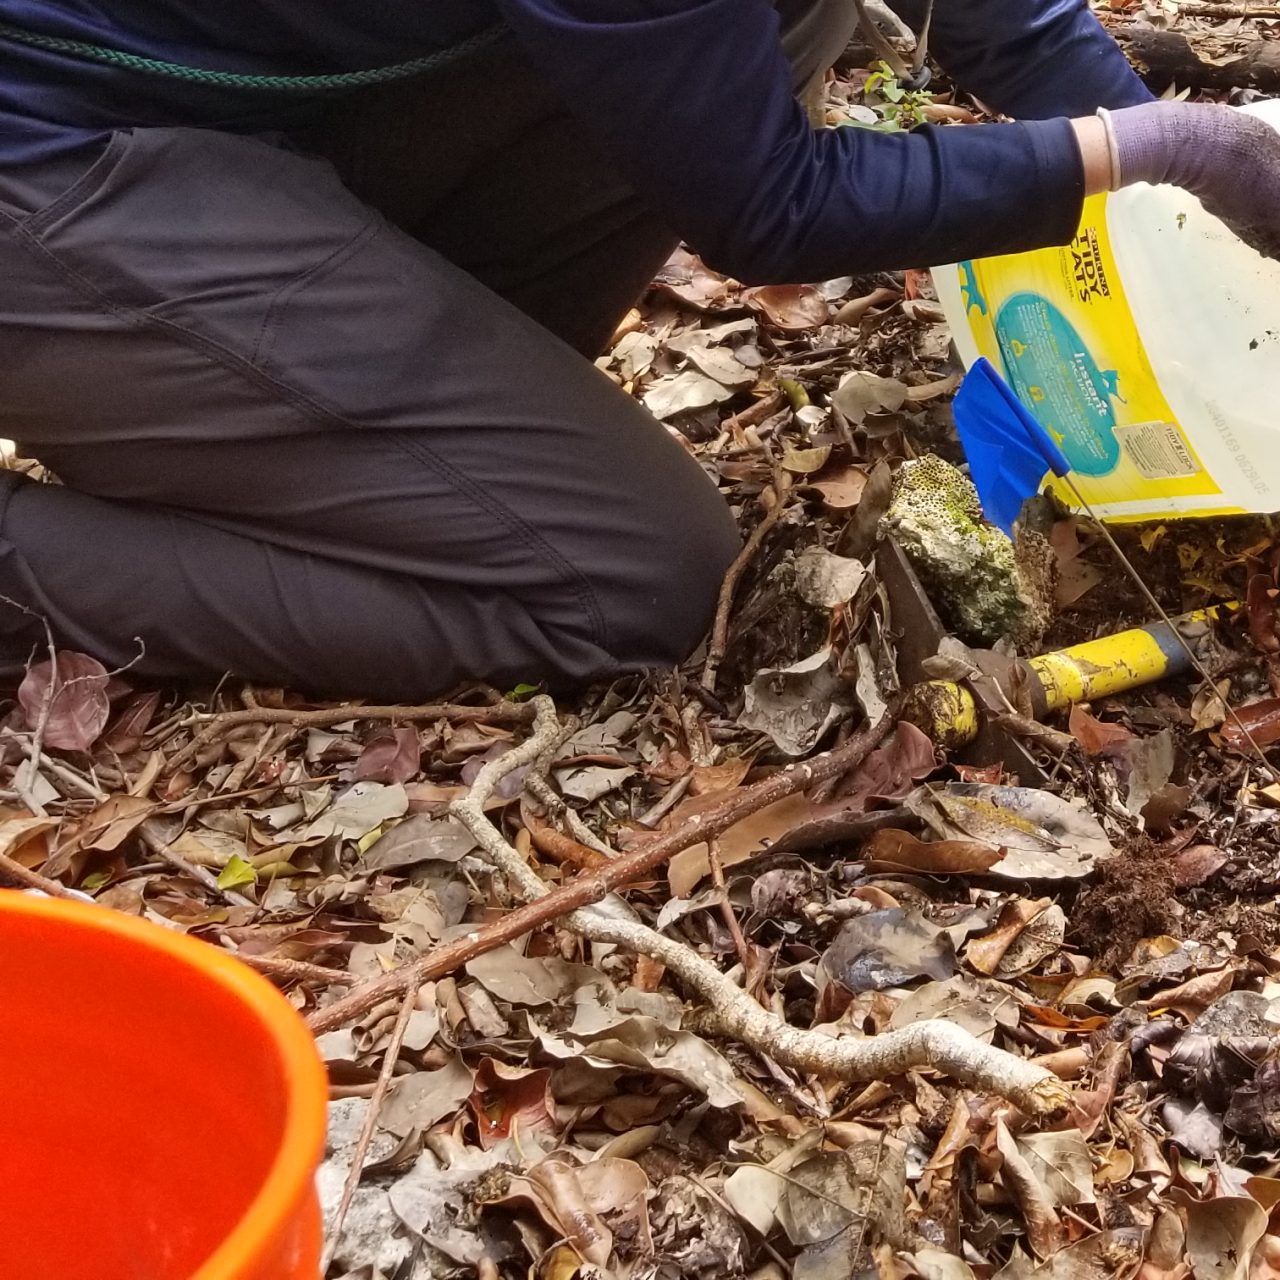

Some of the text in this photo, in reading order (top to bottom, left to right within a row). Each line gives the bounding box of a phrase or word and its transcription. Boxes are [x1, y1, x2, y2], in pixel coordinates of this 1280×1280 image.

[1080, 228, 1102, 298] TIDY
[1091, 238, 1110, 297] PURINA
[1073, 352, 1108, 417] Instant
